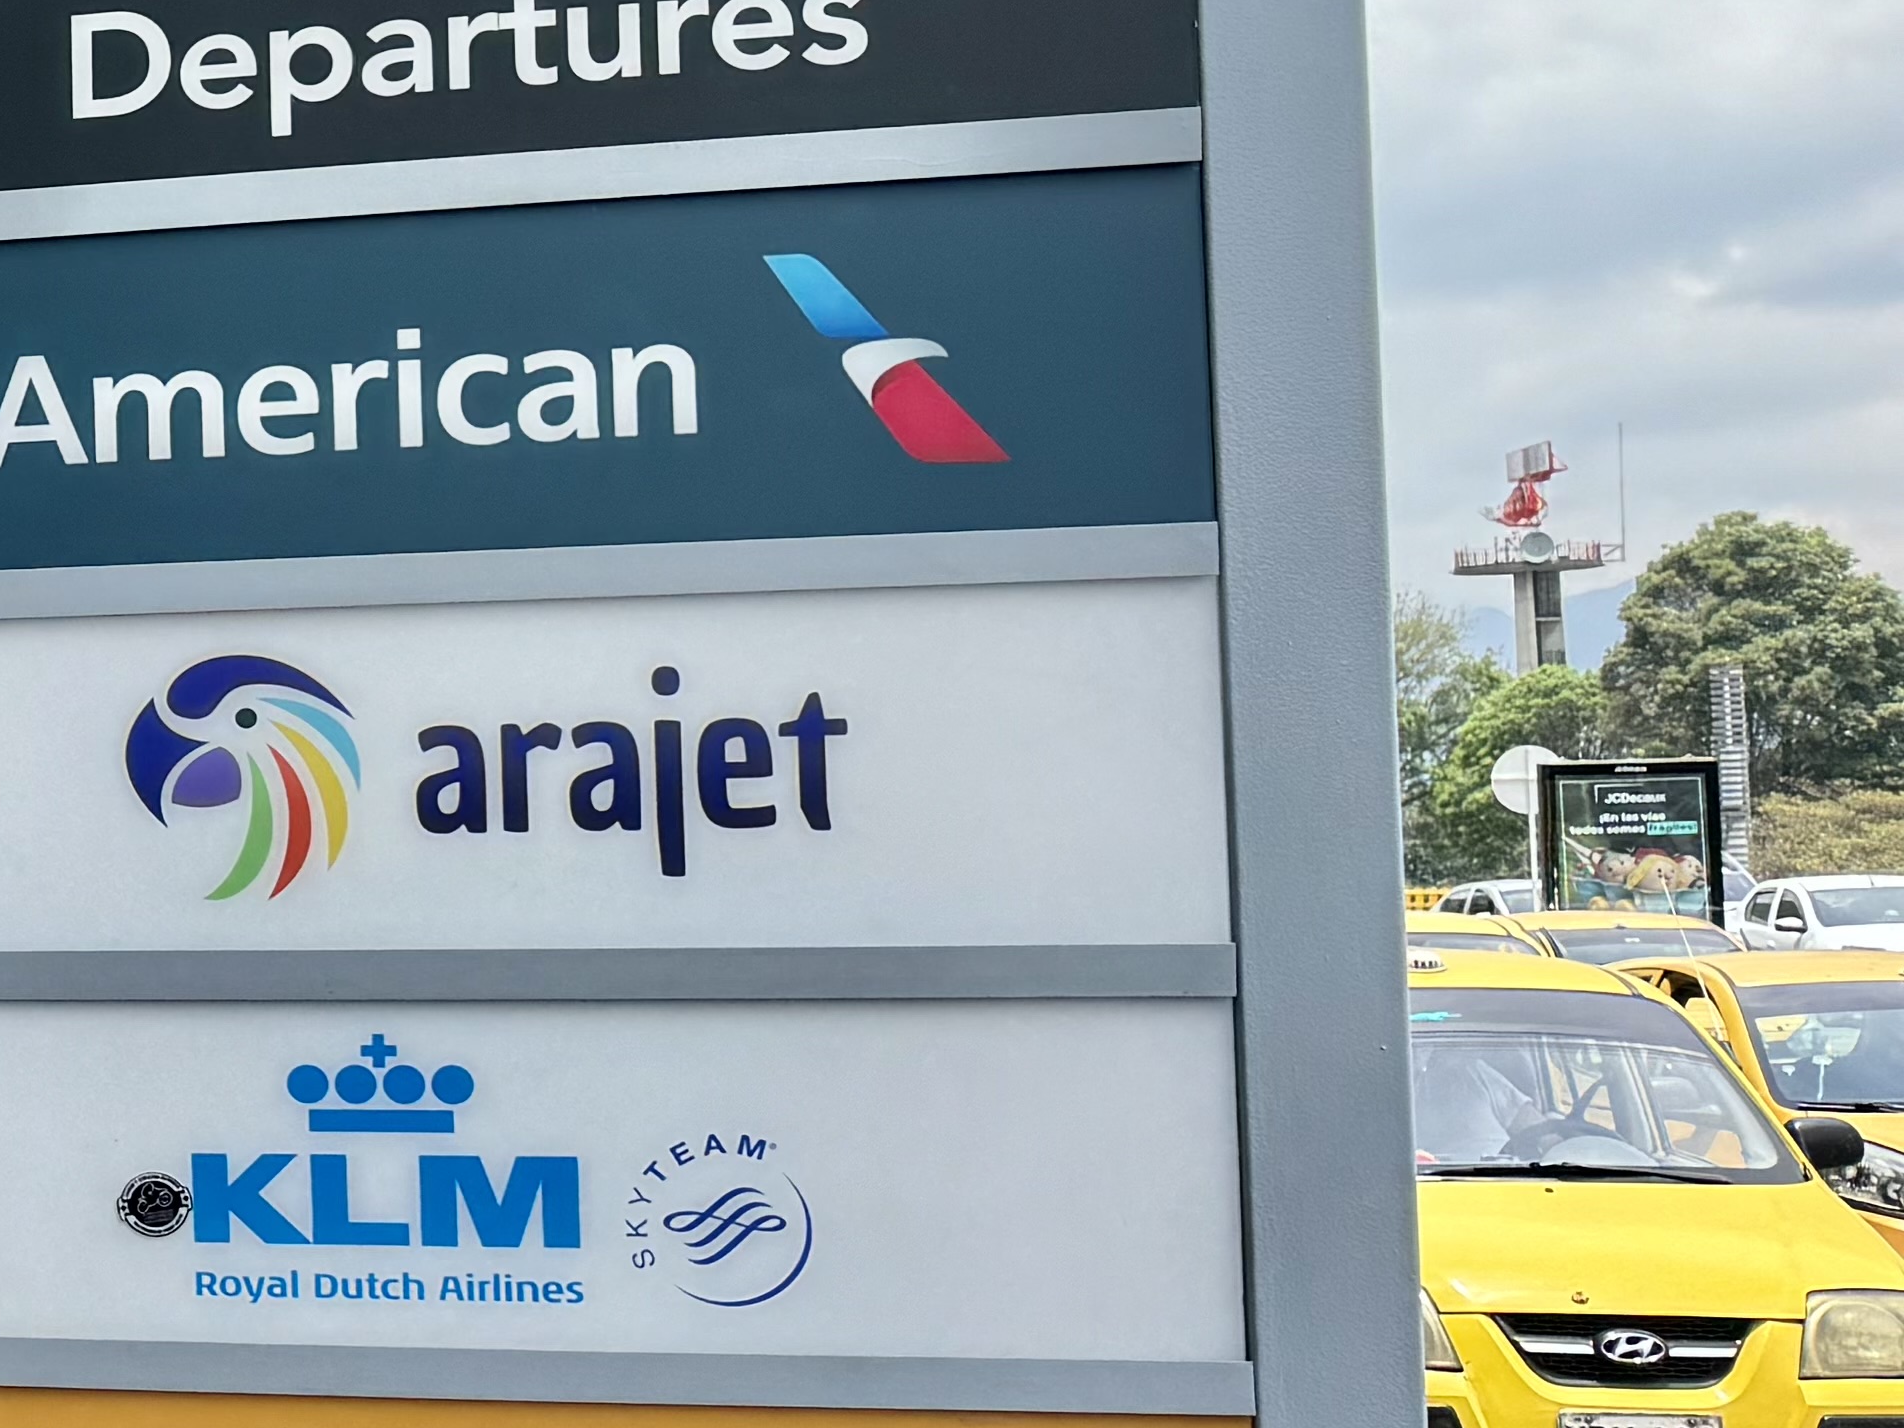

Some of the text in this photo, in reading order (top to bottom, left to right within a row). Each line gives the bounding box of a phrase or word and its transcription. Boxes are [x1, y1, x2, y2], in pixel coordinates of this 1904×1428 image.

[416, 666, 847, 877] arajet
[192, 1152, 582, 1249] KLM
[626, 1134, 766, 1269] SKYTEAM
[194, 1268, 585, 1306] Royal Dutch Airlines
